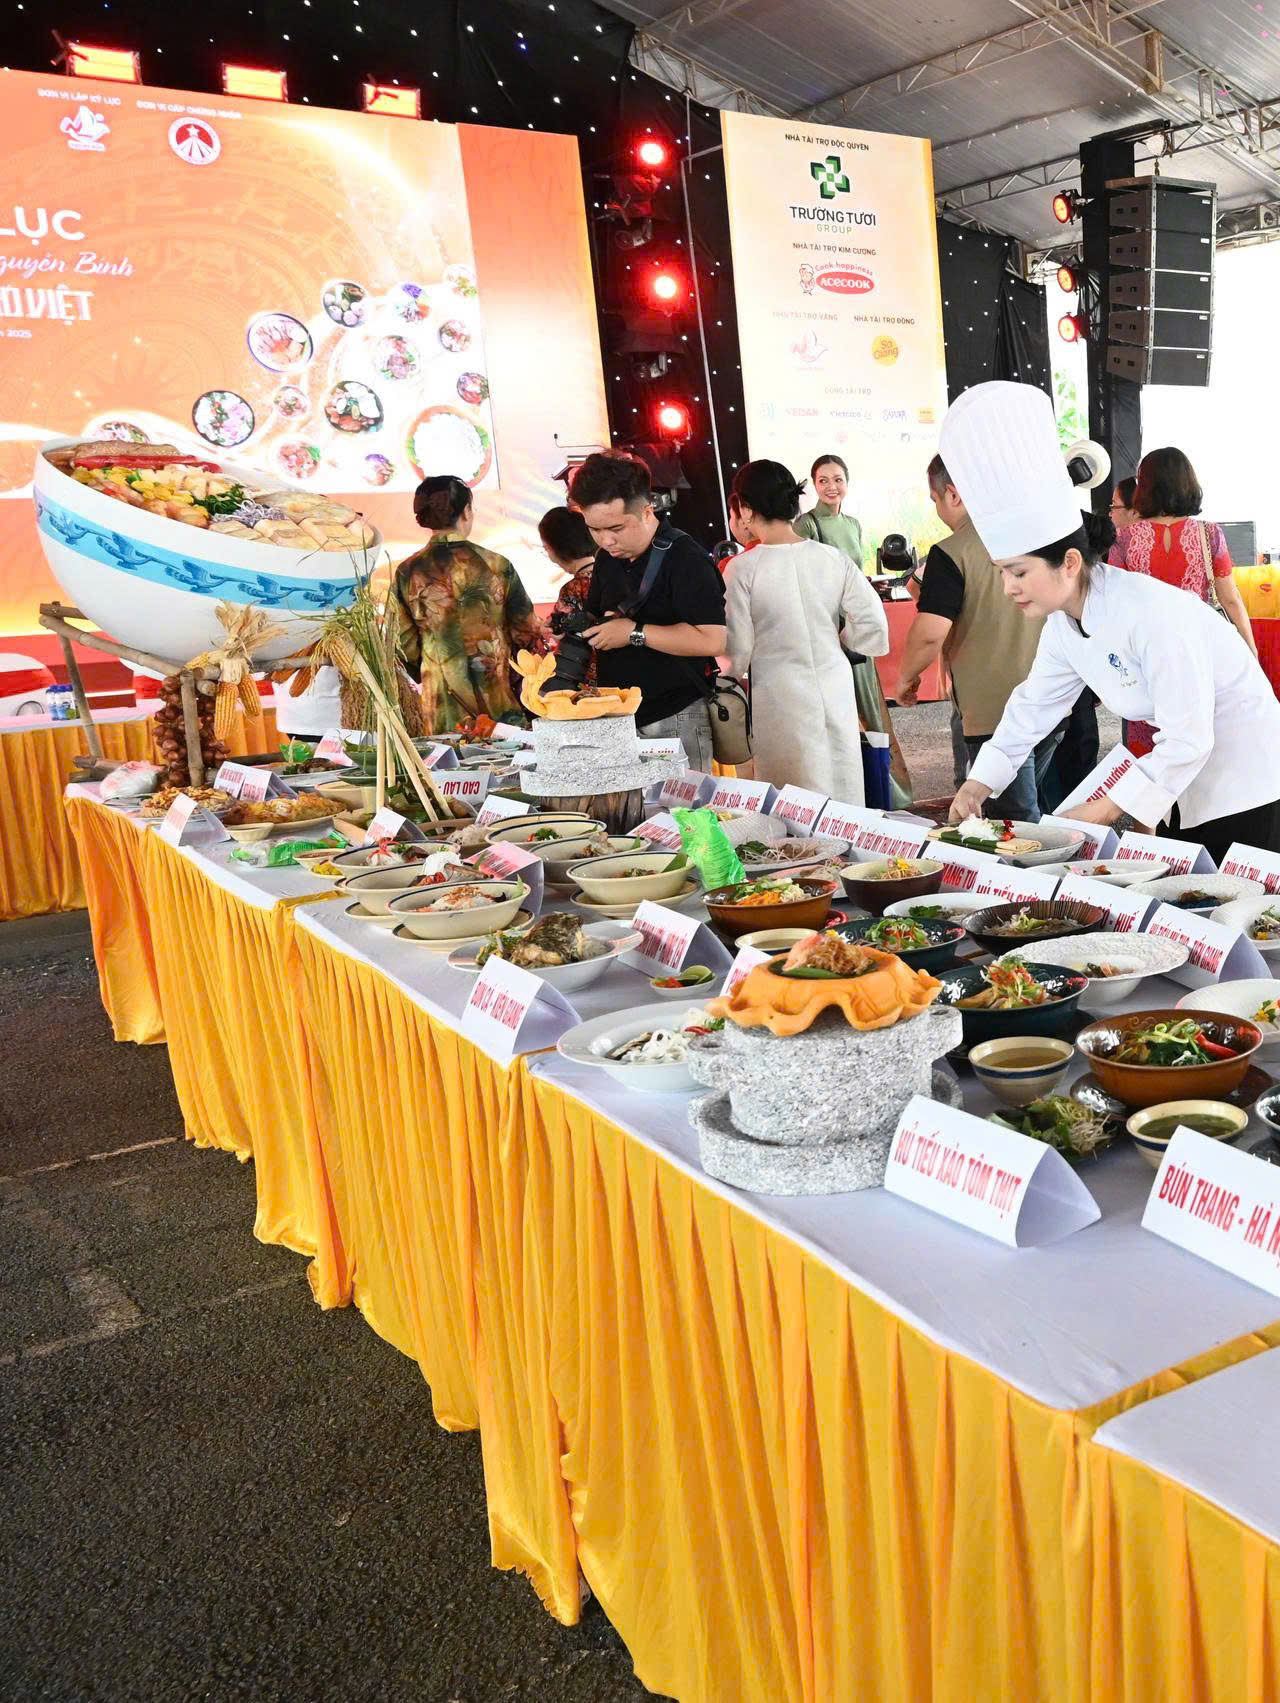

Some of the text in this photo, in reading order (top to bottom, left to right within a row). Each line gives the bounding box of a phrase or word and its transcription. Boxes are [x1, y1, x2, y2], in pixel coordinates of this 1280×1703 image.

[789, 206, 876, 226] TRƯỜNG TƯƠI
[816, 223, 852, 234] GROUP
[894, 1121, 1022, 1219] HỦ TIẾU XÀO TÔM THỊT
[1158, 1162, 1194, 1209] BÚN
[1189, 1178, 1240, 1232] THANG
[1244, 1202, 1273, 1248] HÀ
